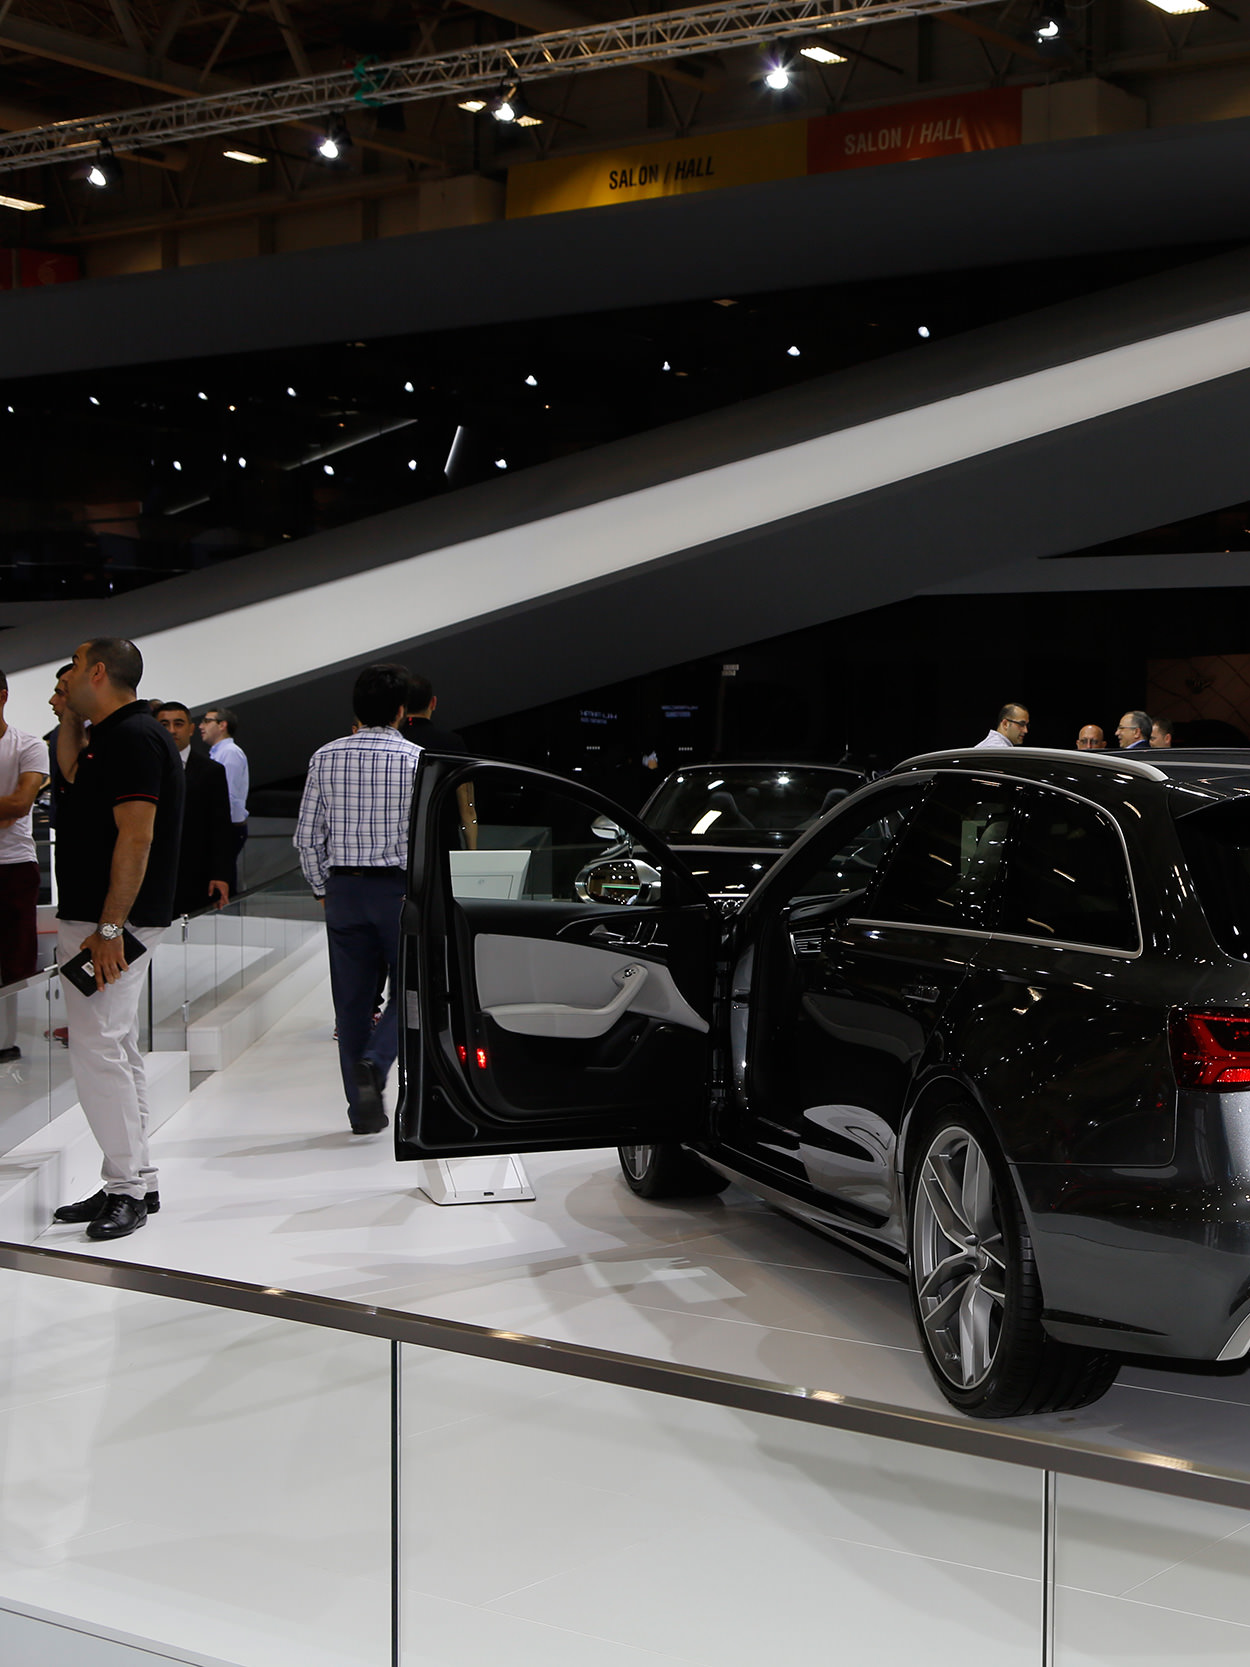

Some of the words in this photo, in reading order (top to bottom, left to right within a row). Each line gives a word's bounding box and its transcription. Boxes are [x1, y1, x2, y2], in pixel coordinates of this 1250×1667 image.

[844, 127, 903, 156] SALON
[919, 117, 965, 145] HALL
[609, 164, 659, 190] SALON
[674, 156, 715, 181] HALL
